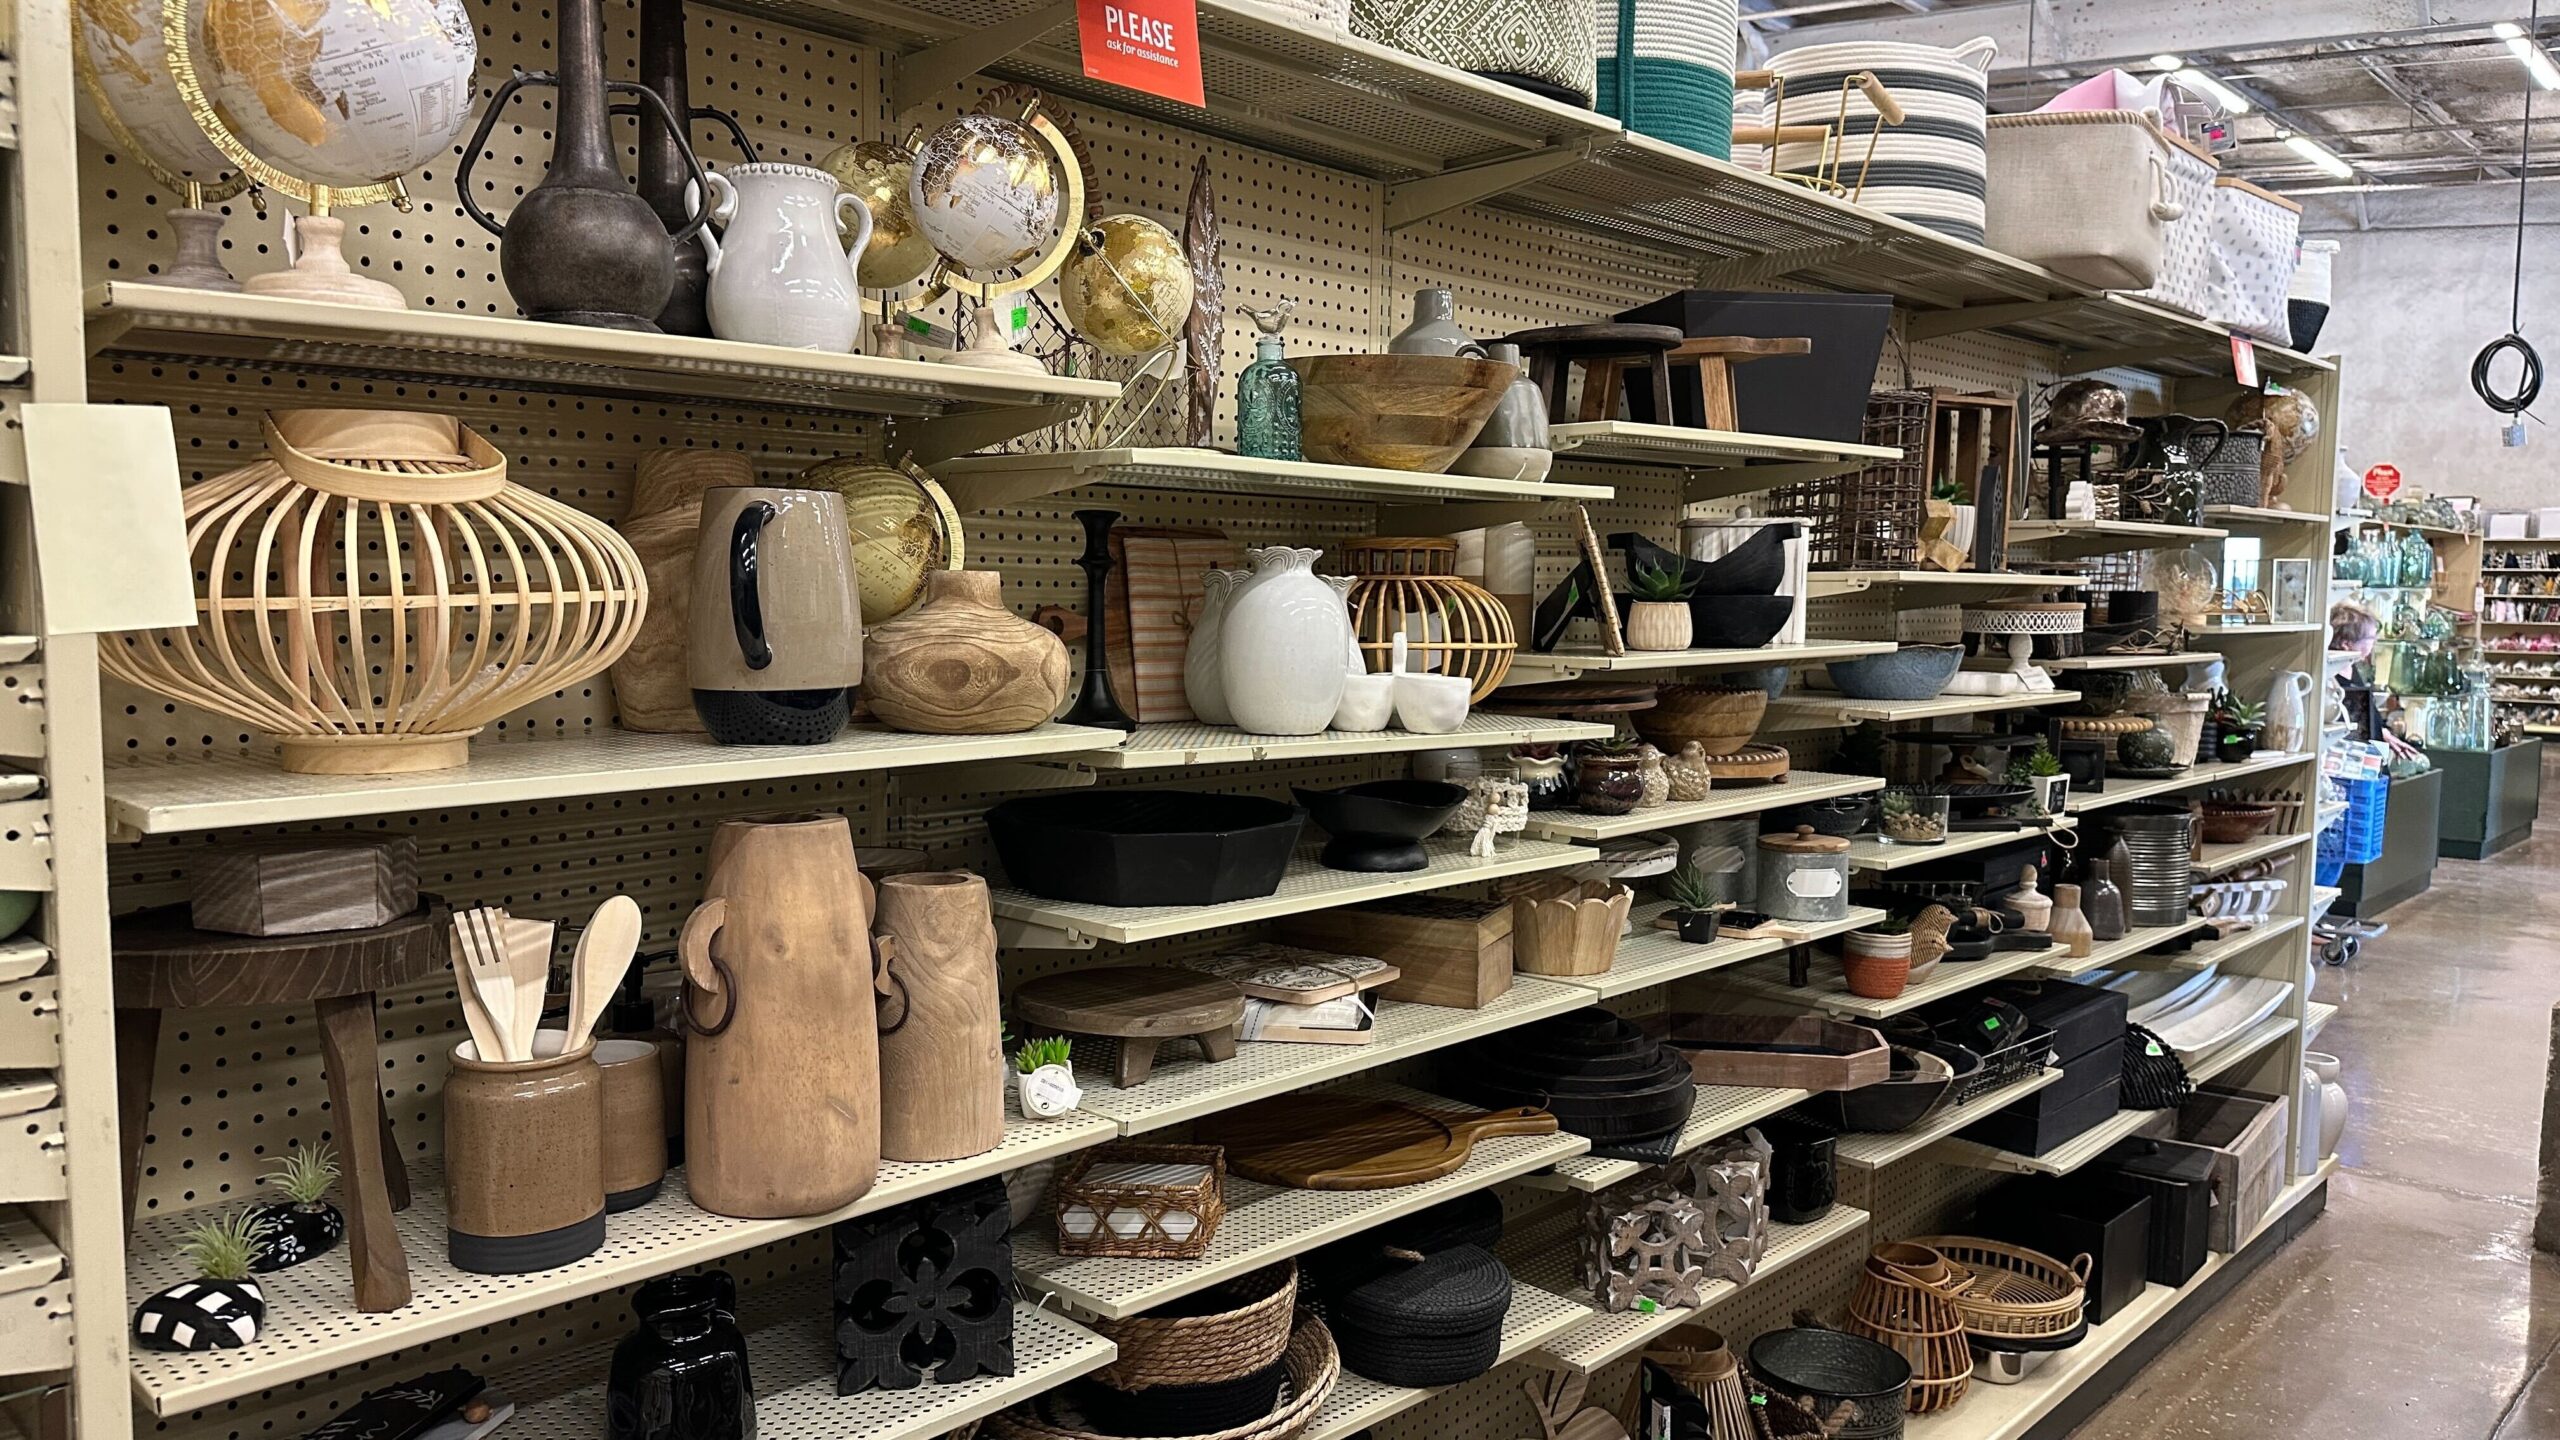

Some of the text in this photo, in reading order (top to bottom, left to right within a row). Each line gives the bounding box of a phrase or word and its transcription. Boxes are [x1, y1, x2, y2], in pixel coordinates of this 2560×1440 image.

[1105, 5, 1176, 52] PLEASE
[1106, 39, 1179, 68] ask for assistance
